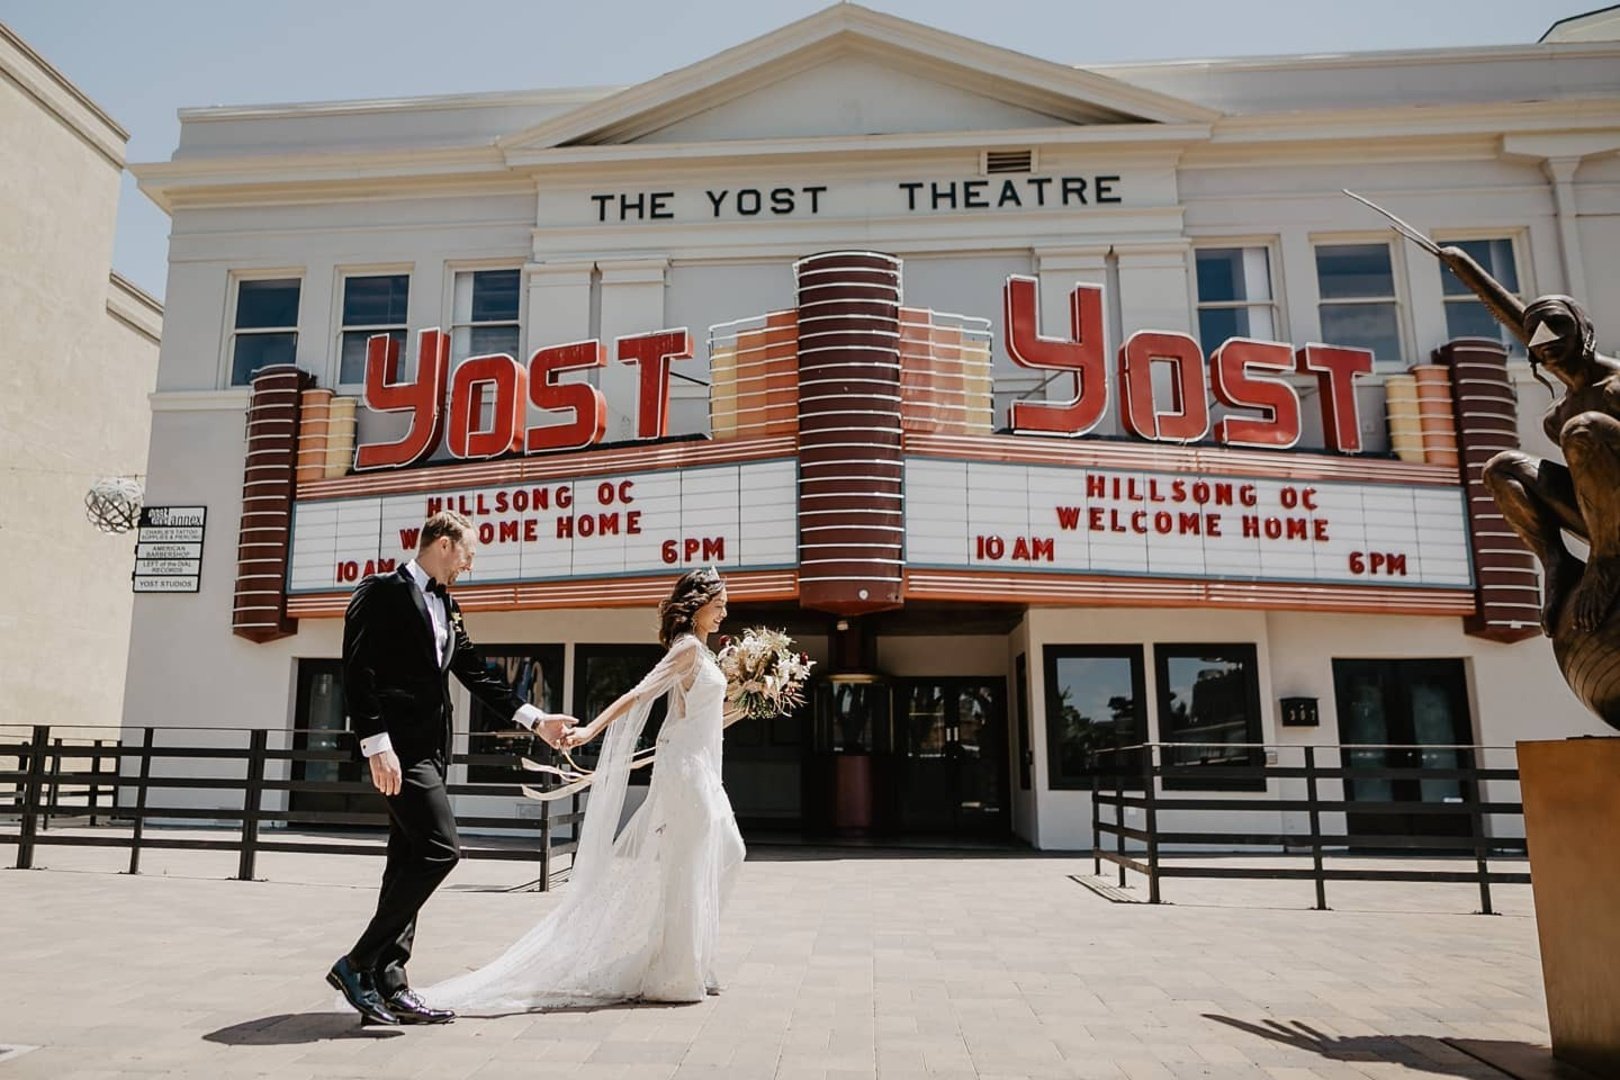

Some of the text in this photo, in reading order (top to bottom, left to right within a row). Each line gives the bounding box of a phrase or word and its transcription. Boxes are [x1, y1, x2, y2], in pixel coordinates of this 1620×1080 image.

[591, 175, 1122, 222] THE YOST THEATRE
[1003, 273, 1375, 455] YOST
[353, 326, 694, 472] YOST
[427, 480, 635, 519] HILLSONG OC
[1086, 474, 1319, 511] HILLSONG OC
[399, 510, 642, 550] WOME HOME
[1056, 505, 1330, 542] WELCOME HOME
[976, 535, 1055, 562] 10 AM
